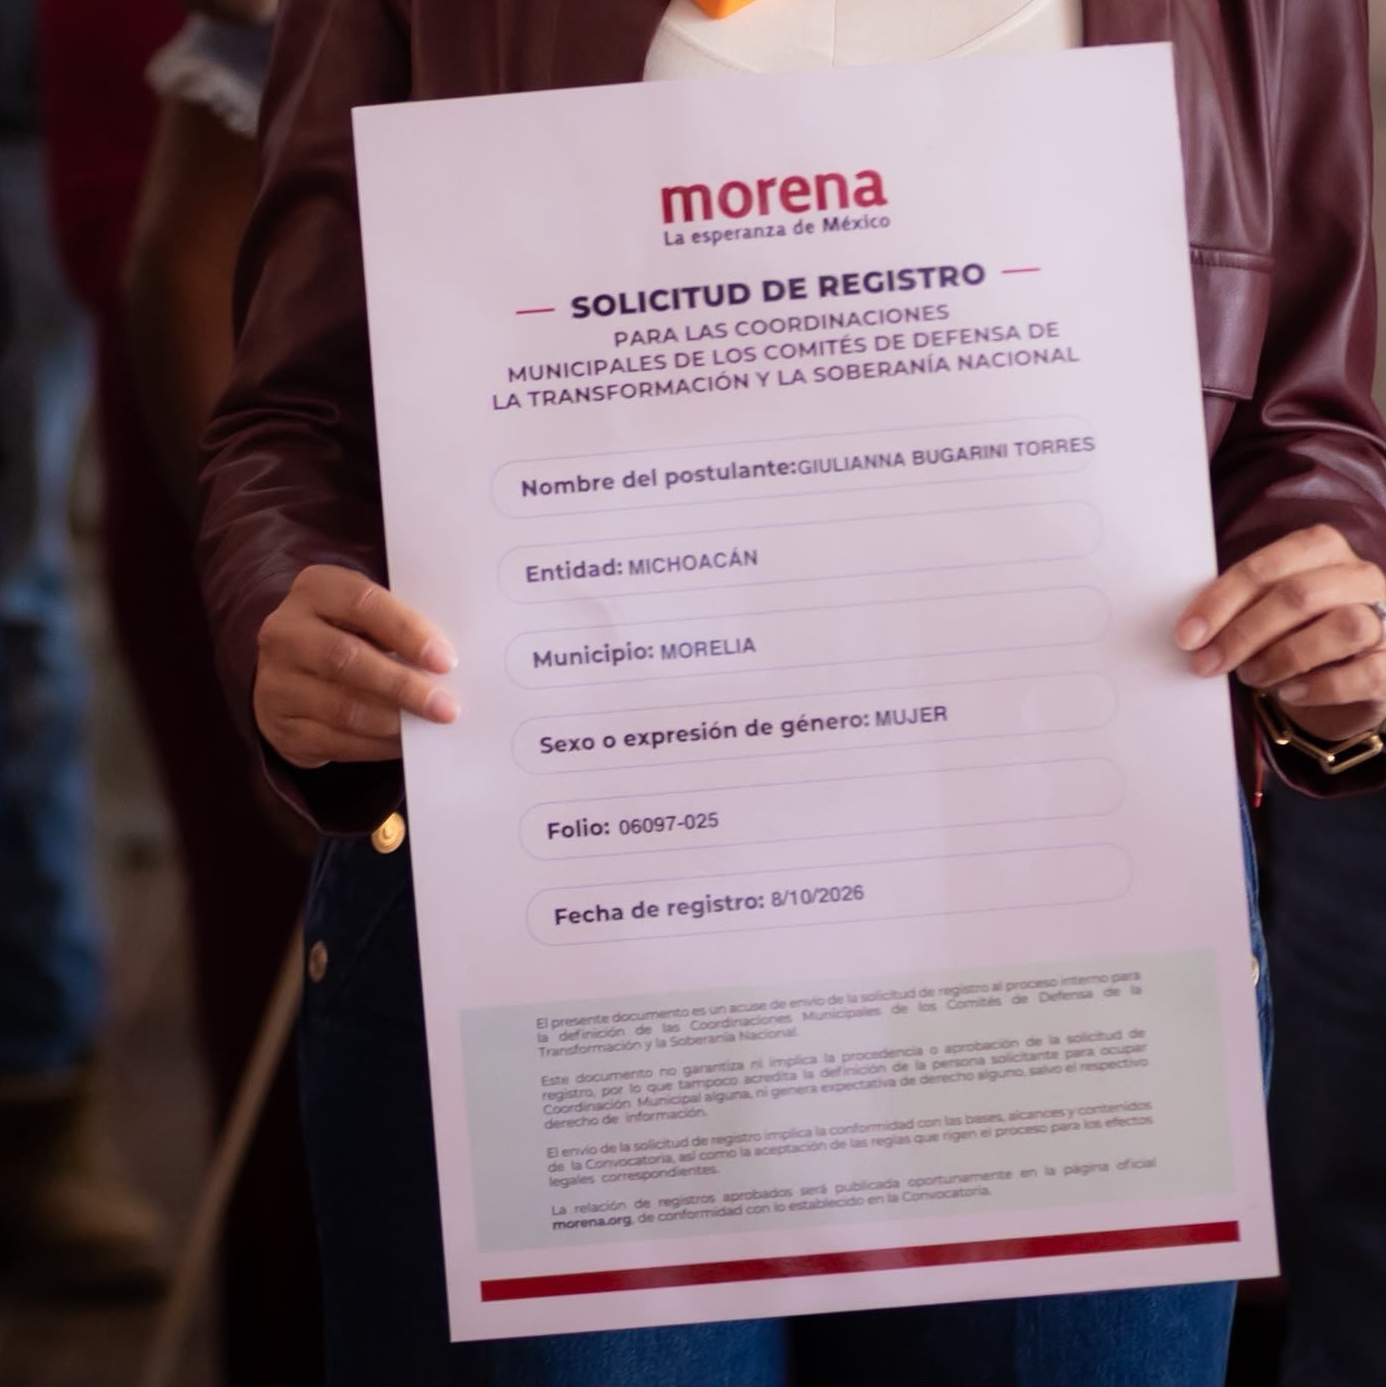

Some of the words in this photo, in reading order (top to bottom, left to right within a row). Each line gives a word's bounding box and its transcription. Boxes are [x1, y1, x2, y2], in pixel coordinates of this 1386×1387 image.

[660, 168, 888, 224] morena
[662, 230, 685, 246] La
[690, 224, 787, 246] esperanza
[791, 218, 815, 235] de
[821, 213, 890, 232] México
[570, 281, 751, 319] SOLICITUD
[761, 276, 808, 302] DE
[817, 262, 986, 298] REGISTRO
[613, 326, 679, 348] PARA
[684, 321, 728, 342] LAS
[733, 303, 950, 337] COORDINACIONES
[506, 353, 667, 383] MUNICIPALES
[673, 349, 706, 369] DE
[711, 345, 757, 365] LOS
[762, 333, 867, 361] COMITÉS
[873, 332, 906, 352] DE
[912, 324, 1021, 349] DEFENSA
[1027, 320, 1059, 339] DE
[491, 392, 522, 411] LA
[526, 370, 749, 407] TRANSFORMACIÓN
[755, 370, 770, 387] Y
[776, 367, 807, 386] LA
[812, 353, 951, 383] SOBERANÍA
[956, 346, 1079, 371] NACIONAL
[520, 473, 615, 497] Nombre
[621, 467, 657, 489] del
[911, 443, 1008, 466] BUGARINI
[1012, 435, 1095, 456] TORRES
[525, 557, 623, 583] Entidad:
[627, 546, 758, 576] MICHOACÁN
[531, 640, 654, 669] Municipio:
[659, 636, 756, 660] MORELIA
[539, 735, 595, 754] Sexo
[601, 734, 616, 749] o
[622, 720, 737, 749] expresión
[743, 717, 773, 737] de
[779, 713, 870, 738] género:
[874, 704, 947, 726] MUJER
[546, 816, 610, 840] Folio:
[618, 811, 719, 835] 06097-025
[553, 903, 624, 926] Fecha
[630, 899, 660, 919] de
[666, 893, 764, 919] registro:
[770, 884, 864, 907] 8/10/2026
[535, 1031, 549, 1044] la
[557, 1025, 626, 1042] definición
[633, 1023, 653, 1036] de
[660, 1021, 681, 1034] las
[688, 1013, 793, 1031] Coordinaciones
[801, 1005, 882, 1021] Municipales
[890, 1002, 909, 1015] de
[916, 1000, 938, 1012] los
[945, 995, 1002, 1010] Comités
[1010, 993, 1029, 1005] de
[1037, 989, 1094, 1003] Defensa
[1102, 986, 1121, 998] de
[1129, 983, 1143, 995] la
[536, 1038, 642, 1058] Transformación
[642, 1039, 653, 1052] y
[654, 1036, 667, 1049] la
[668, 1030, 736, 1048] Soberanía
[737, 1025, 798, 1041] Nacional.
[542, 1114, 600, 1130] derecho
[600, 1112, 620, 1125] de
[624, 1105, 709, 1124] información.
[547, 1173, 596, 1189] legales
[600, 1164, 720, 1184] correspondientes.
[550, 1204, 567, 1216] La
[573, 1199, 627, 1214] relación
[632, 1197, 652, 1213] de
[656, 1193, 716, 1210] registros
[721, 1187, 793, 1205] aprobados
[798, 1182, 828, 1197] será
[833, 1177, 901, 1195] publicada
[906, 1169, 1013, 1188] oportunamente
[1018, 1167, 1037, 1178] en
[1043, 1165, 1056, 1176] la
[1062, 1161, 1110, 1177] página
[1115, 1156, 1157, 1171] oficial
[551, 1214, 635, 1231] morena.org,
[636, 1211, 655, 1224] de
[656, 1203, 743, 1222] conformidad
[744, 1204, 771, 1215] con
[772, 1201, 786, 1212] lo
[787, 1195, 865, 1211] establecido
[866, 1195, 884, 1205] en
[886, 1192, 899, 1203] la
[901, 1186, 990, 1202] Convocatoria.
